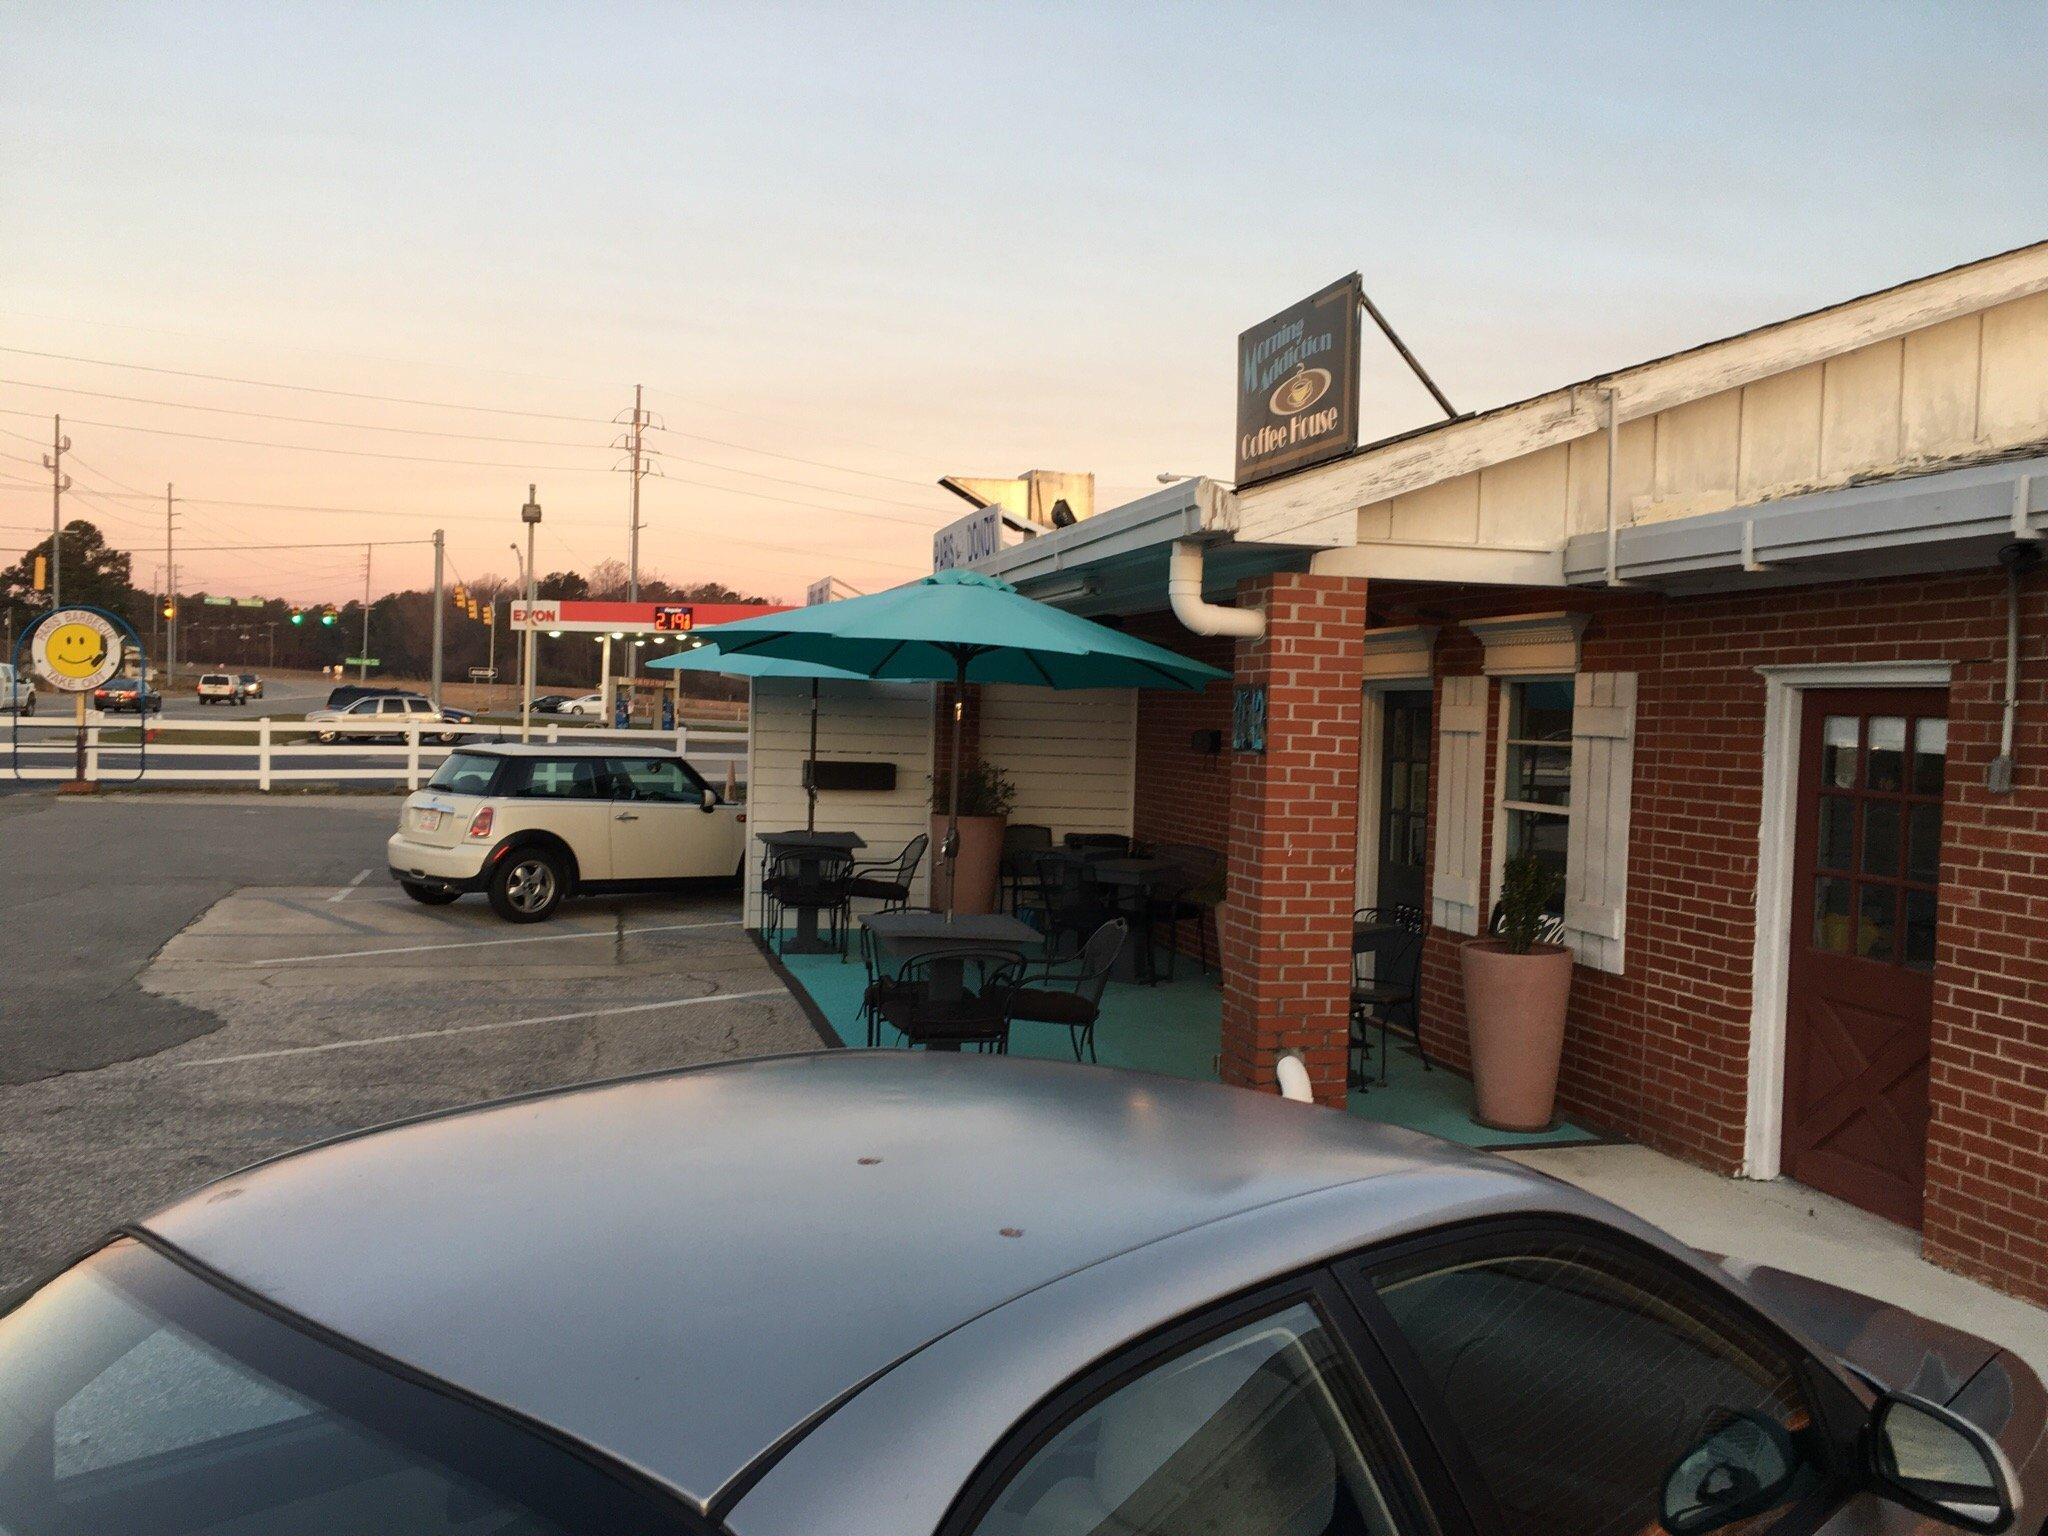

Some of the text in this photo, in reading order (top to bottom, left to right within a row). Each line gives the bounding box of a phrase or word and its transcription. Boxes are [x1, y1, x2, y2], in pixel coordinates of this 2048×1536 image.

[1244, 318, 1305, 393] Morning
[1242, 406, 1338, 461] Coffee House
[513, 609, 555, 626] EXXON
[46, 670, 75, 688] TAKE
